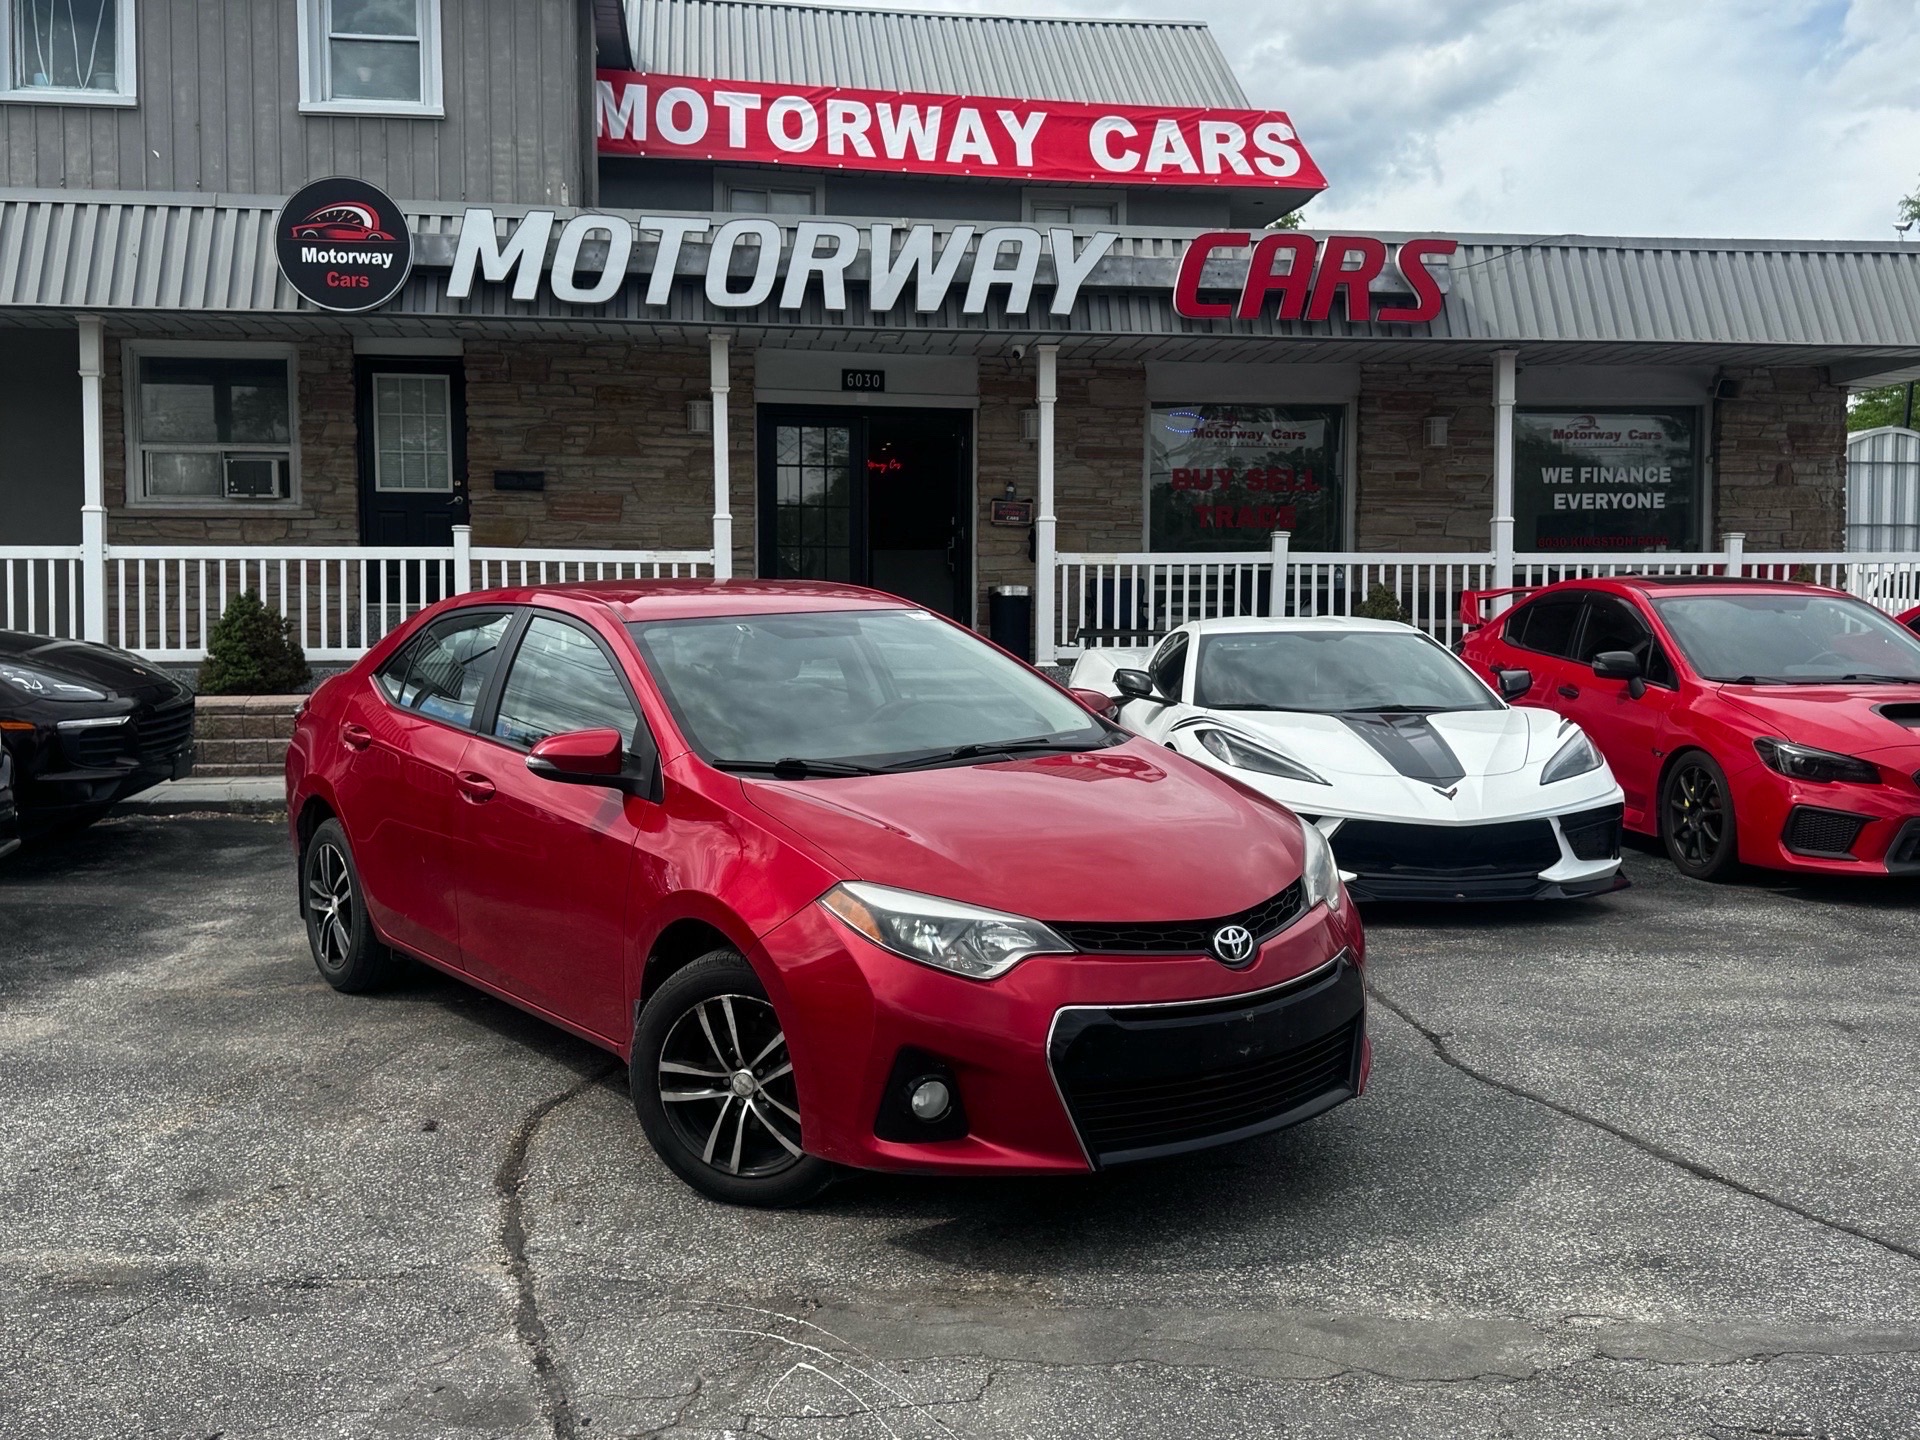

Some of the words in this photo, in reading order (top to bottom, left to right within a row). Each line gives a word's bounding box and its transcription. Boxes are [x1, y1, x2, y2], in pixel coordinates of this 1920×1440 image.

[597, 80, 1047, 167] MOTORWAY
[1089, 115, 1301, 178] CARS
[301, 247, 394, 269] Motorway
[446, 207, 1121, 316] MOTORWAY
[1172, 231, 1459, 323] CARS
[326, 271, 370, 288] Cars
[847, 373, 880, 387] 6030
[1193, 428, 1264, 441] Motorway
[1271, 429, 1307, 440] Cars
[1552, 429, 1622, 442] Motorway
[1628, 429, 1663, 440] Cars
[1171, 468, 1235, 492] BUY
[1246, 468, 1323, 493] SELL
[1541, 467, 1573, 484] WE
[1580, 466, 1672, 484] FINANCE
[1553, 492, 1666, 510] EVERYONE
[1193, 505, 1297, 529] TRADE
